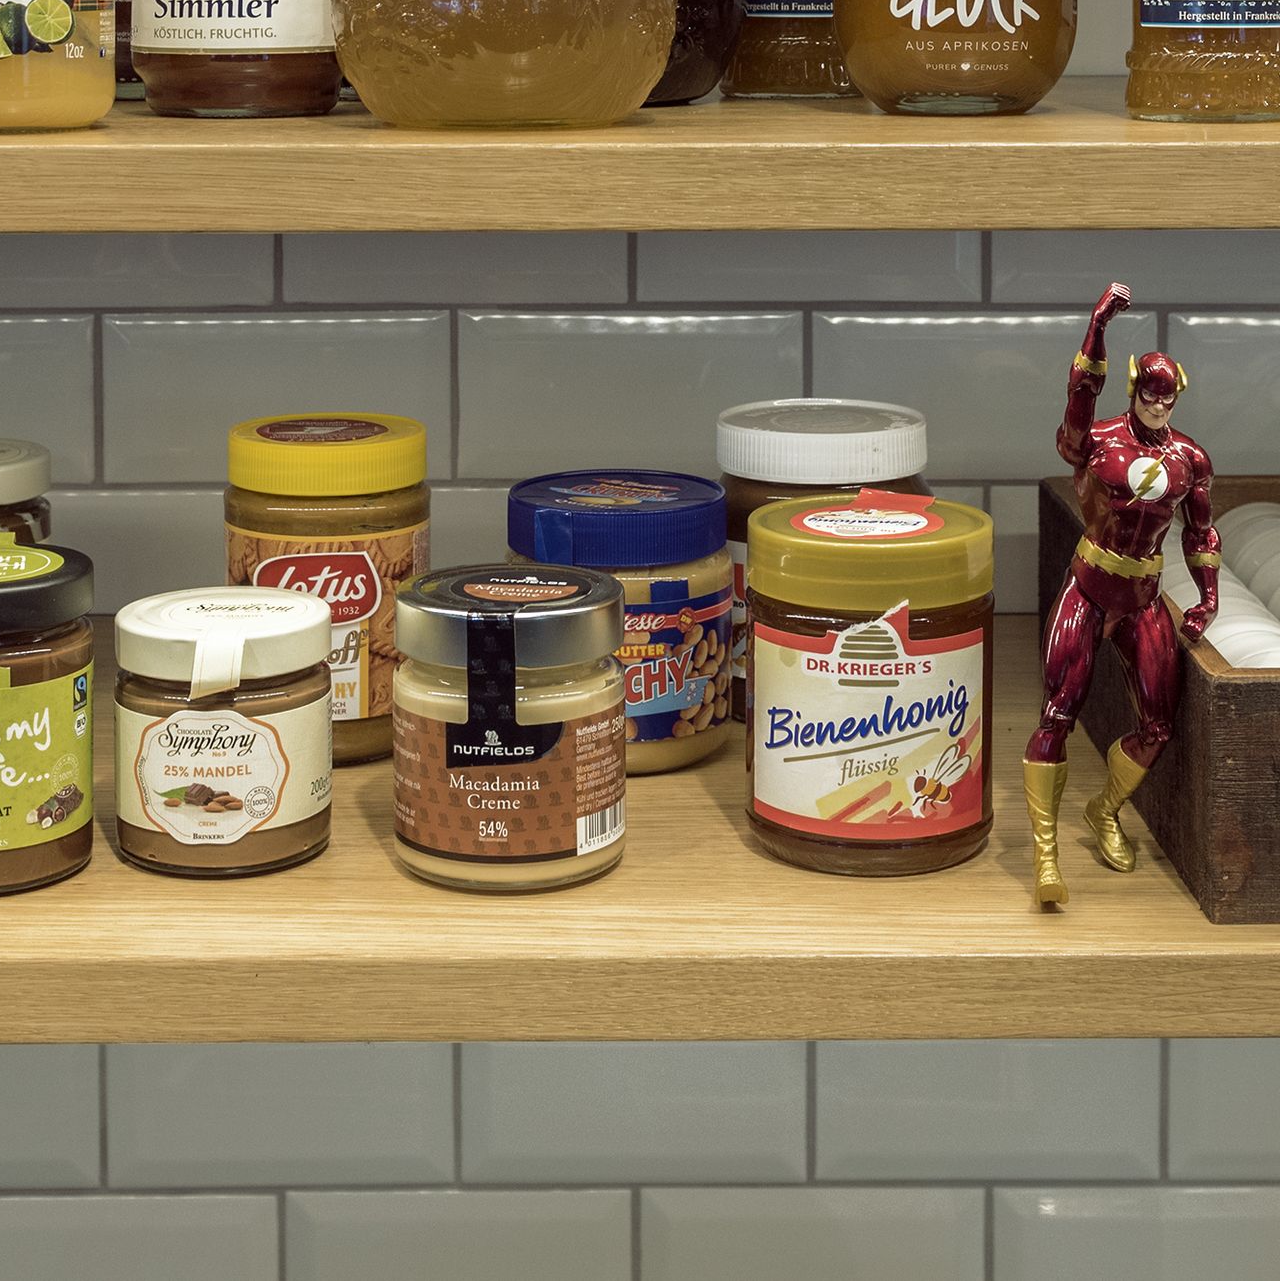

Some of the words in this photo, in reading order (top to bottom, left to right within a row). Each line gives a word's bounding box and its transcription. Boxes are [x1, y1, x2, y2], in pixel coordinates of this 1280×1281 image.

[1178, 10, 1231, 22] Hergestellt
[1233, 10, 1243, 21] in
[153, 26, 208, 41] KÖSTLICH.
[209, 26, 278, 40] FRUCHTIG.
[64, 43, 85, 59] 12oz
[905, 40, 935, 51] AUS
[942, 40, 1030, 52] APRIKOSEN
[925, 62, 958, 71] PURER
[973, 63, 1010, 71] GENUSS
[338, 606, 361, 616] 1932
[624, 649, 693, 706] CHY
[764, 678, 970, 750] Bienenhonig
[5, 706, 52, 752] my
[176, 728, 213, 736] CHOCOLATE
[157, 722, 257, 758] Symphony
[453, 744, 535, 757] NUTFIELDS
[163, 764, 190, 778] 25%
[193, 764, 253, 778] MANDEL
[837, 753, 900, 786] flüssig
[448, 773, 541, 791] Macadamia
[466, 793, 521, 811] Creme
[478, 820, 508, 837] 54%
